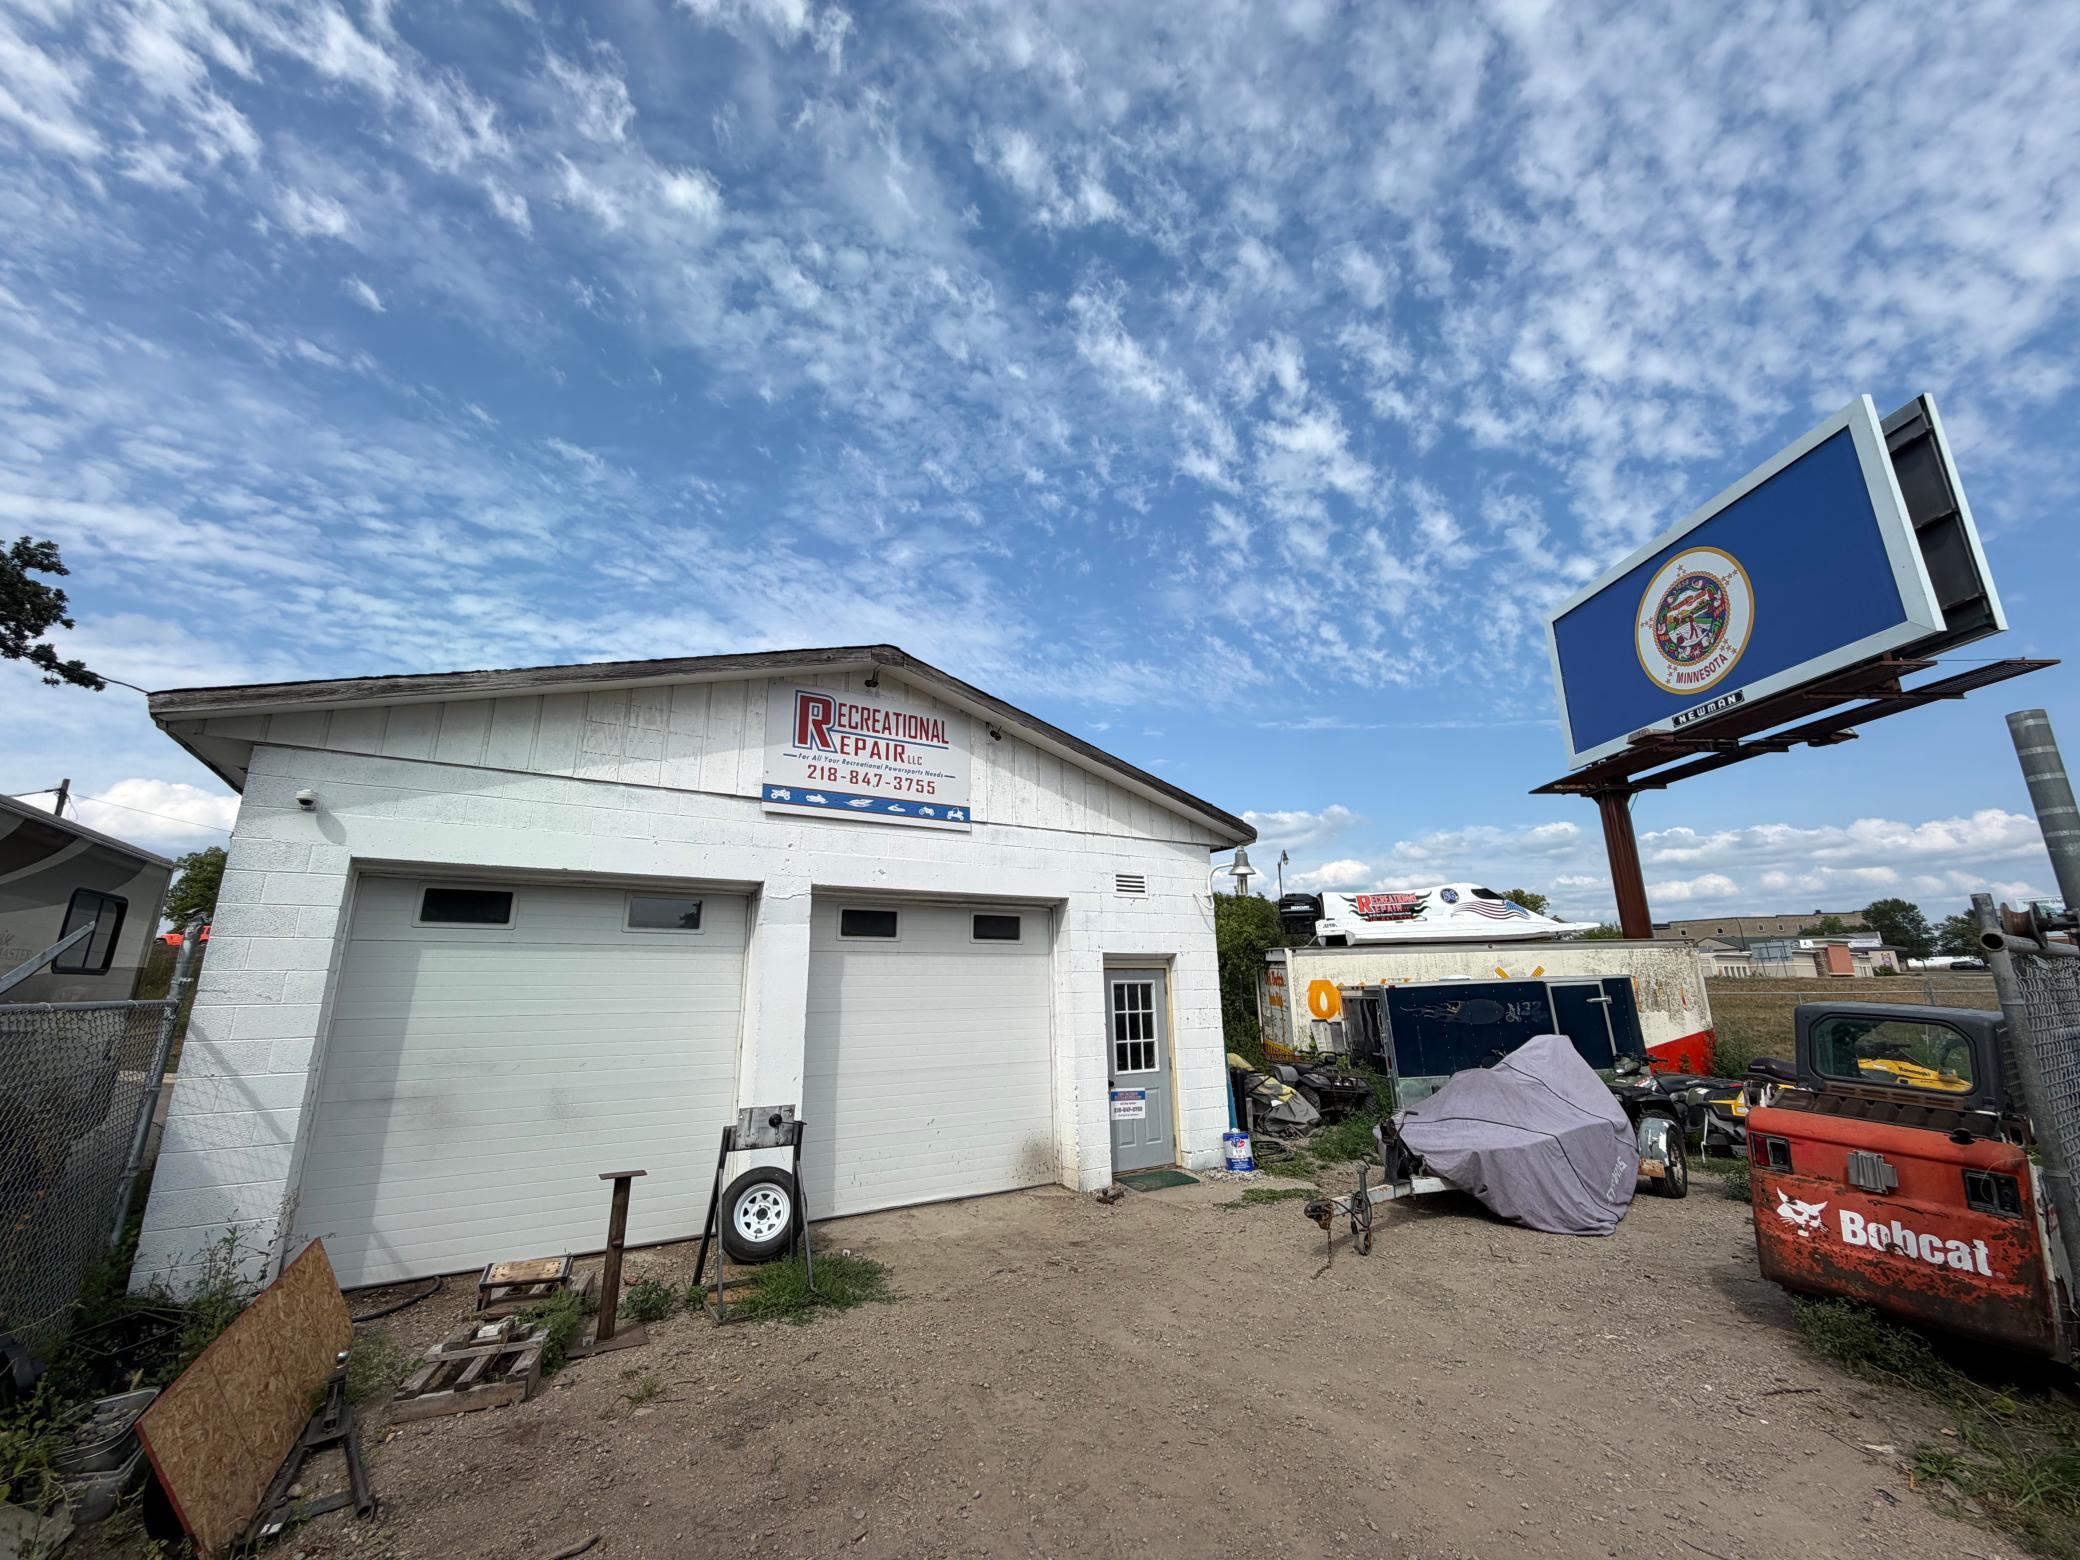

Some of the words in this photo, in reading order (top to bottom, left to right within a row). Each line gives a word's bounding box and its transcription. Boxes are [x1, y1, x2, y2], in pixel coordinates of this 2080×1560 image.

[1676, 653, 1728, 684] MINNESOTA
[793, 690, 949, 753] RECREATIONAL
[1678, 694, 1736, 724] NEWMAN
[812, 754, 822, 762] All
[824, 756, 841, 764] Your
[841, 758, 883, 770] Recreational
[884, 765, 924, 776] Powersports
[925, 770, 944, 778] Needs
[908, 755, 923, 766] LLC
[807, 764, 936, 795] 218-847-3755
[1839, 1209, 1993, 1277] Bobcat
